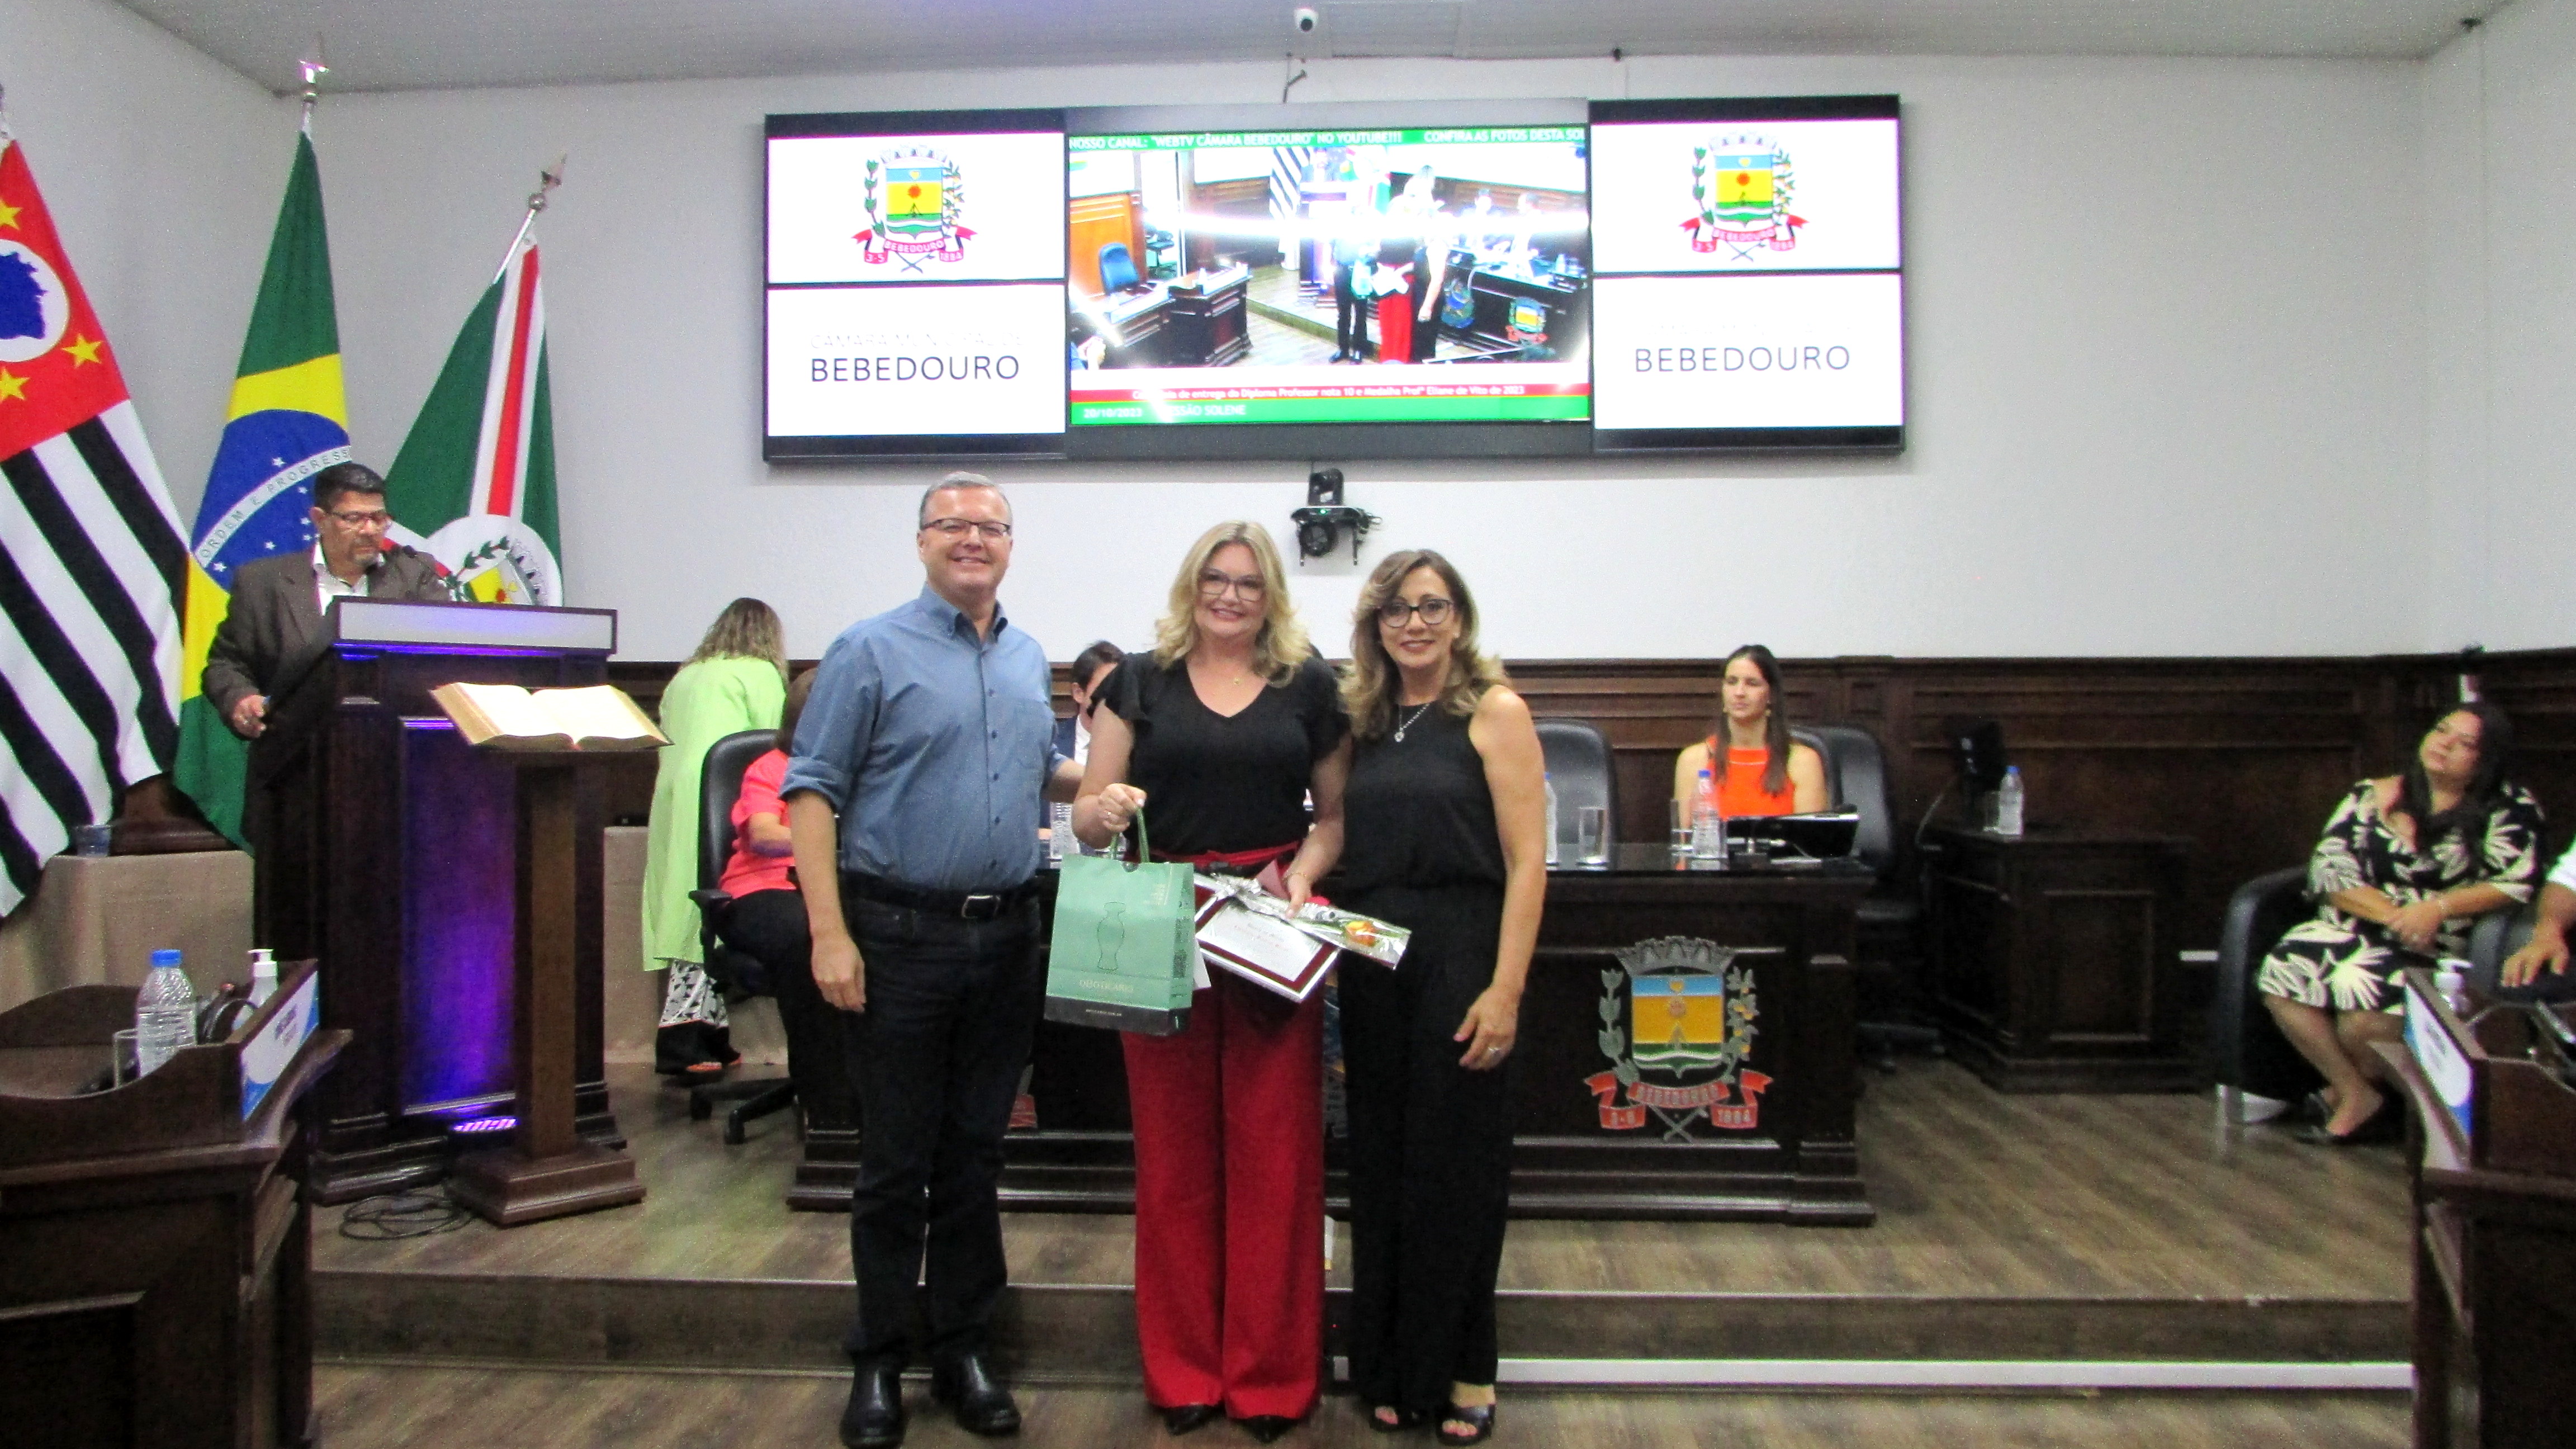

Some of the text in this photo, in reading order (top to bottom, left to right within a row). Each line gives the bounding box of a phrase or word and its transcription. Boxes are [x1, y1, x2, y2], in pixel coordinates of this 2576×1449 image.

[1069, 136, 1106, 149] NOSSO
[1107, 135, 1149, 148] CANAL:
[1197, 132, 1242, 146] CÂMARA
[1317, 132, 1334, 144] NO
[1474, 129, 1488, 141] AS
[1490, 129, 1527, 141] FOTOS
[1530, 128, 1565, 141] DESTA
[884, 239, 944, 253] BEBEDOURO
[1635, 345, 1850, 372] BEBEDOURO
[811, 356, 1019, 382] BEBEDOURO
[1241, 389, 1277, 399] Diploma
[1278, 387, 1319, 397] Professor
[1344, 387, 1354, 396] 10
[1455, 386, 1468, 395] de
[1489, 385, 1502, 395] de
[1084, 408, 1143, 418] 20/10/2023
[1204, 404, 1246, 416] SOLENE
